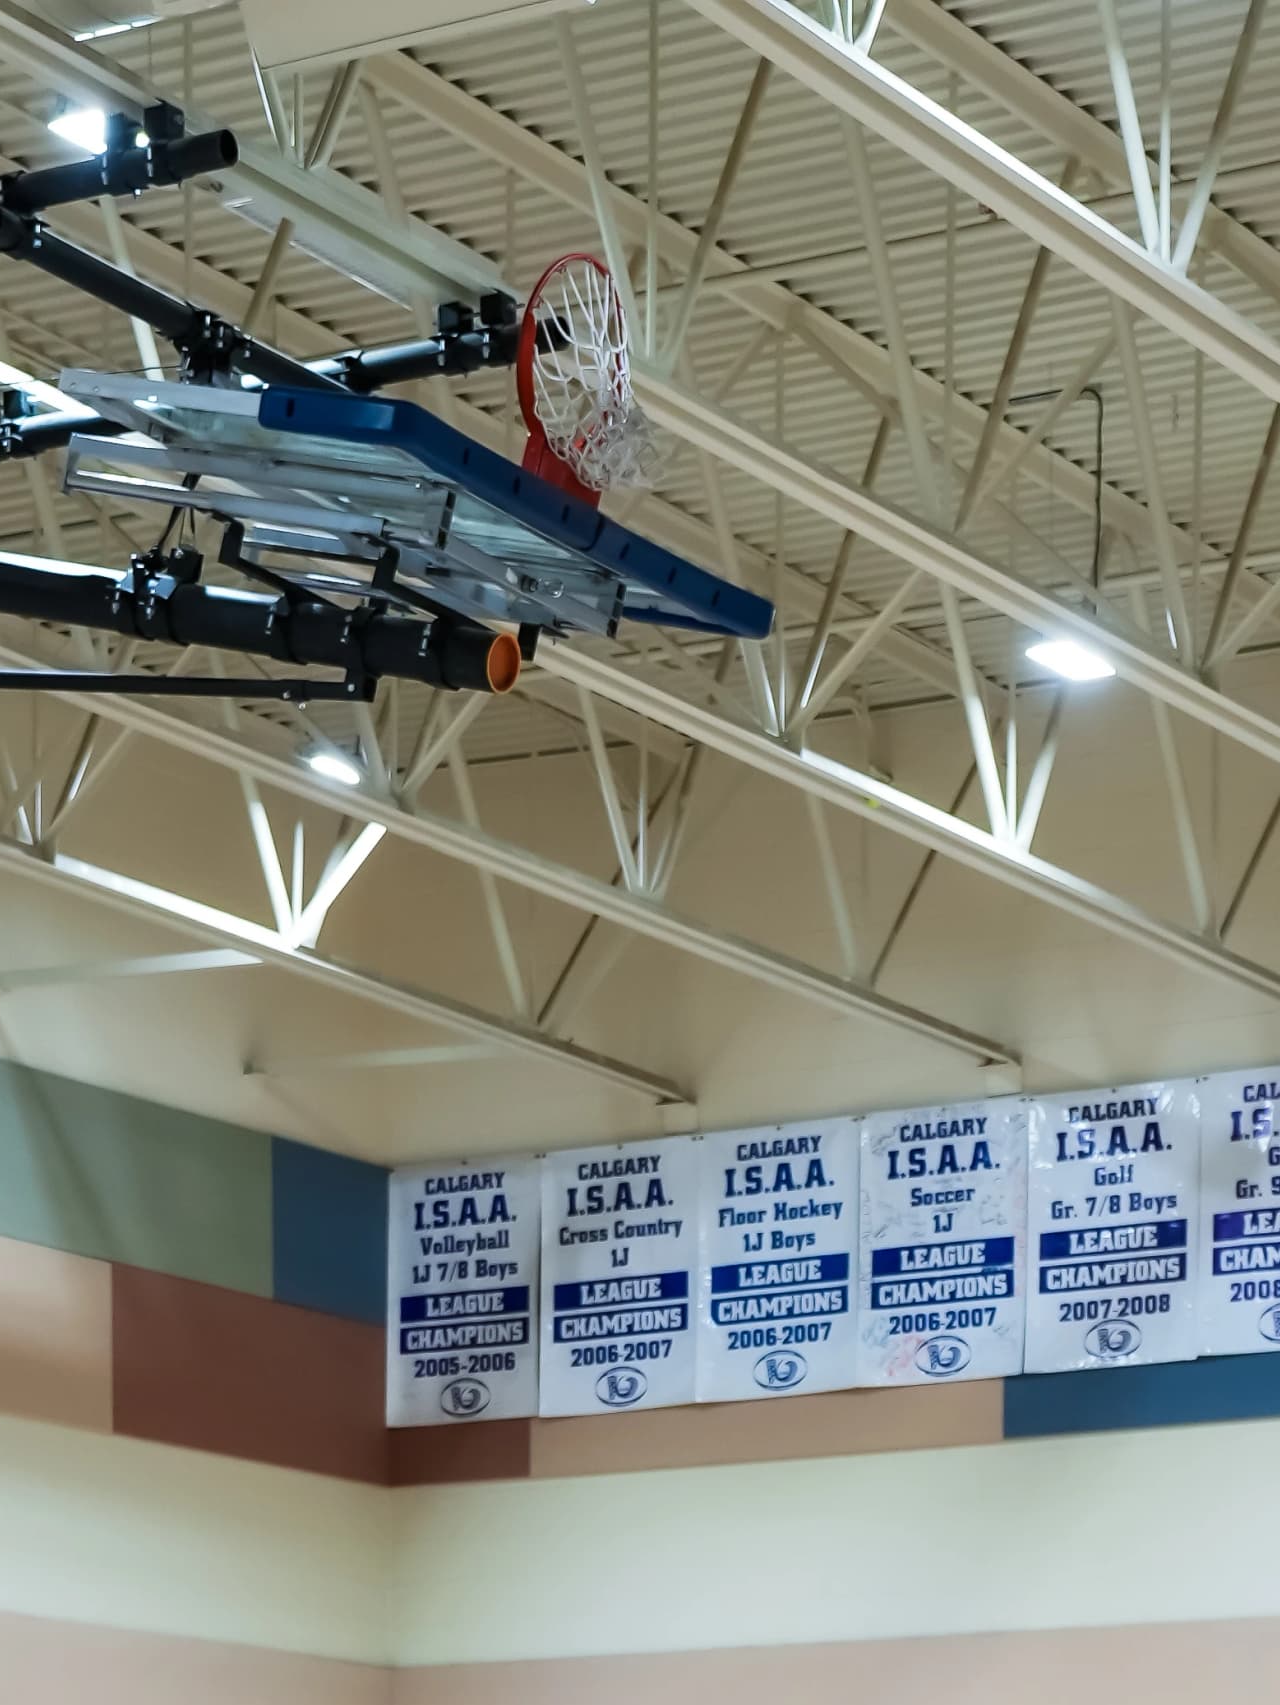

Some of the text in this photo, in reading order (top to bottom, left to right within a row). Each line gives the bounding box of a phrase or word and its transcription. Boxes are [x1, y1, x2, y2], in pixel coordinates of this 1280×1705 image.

[1068, 1098, 1158, 1124] CALGARY
[900, 1117, 987, 1142] CALGARY
[1057, 1122, 1172, 1162] I.S.A.A.
[737, 1135, 821, 1161] CALGARY
[887, 1141, 1000, 1180] I.S.A.A.
[578, 1155, 661, 1181] CALGARY
[725, 1159, 835, 1198] I.S.A.A.
[1094, 1165, 1134, 1187] Golf
[425, 1171, 505, 1196] CALGARY
[567, 1178, 673, 1217] I.S.A.A.
[911, 1187, 975, 1207] Soccer
[1236, 1179, 1263, 1200] Gr.
[414, 1195, 517, 1231] I.S.A.A.
[719, 1199, 842, 1228] Floor Hockey
[1051, 1192, 1177, 1220] Gr. 7/8 Boys
[559, 1218, 682, 1246] Cross Country
[933, 1213, 953, 1233] 1J
[420, 1230, 510, 1257] Volleyball
[743, 1230, 815, 1252] 1J Boys
[1070, 1226, 1158, 1255] LEAGUE
[611, 1248, 629, 1268] 1J
[900, 1242, 985, 1271] LEAGUE
[413, 1258, 519, 1284] 1J 7/8 Boys
[739, 1259, 821, 1287] LEAGUE
[1046, 1257, 1180, 1290] CHAMPIONS
[581, 1278, 661, 1306] LEAGUE
[878, 1274, 1007, 1306] CHAMPIONS
[426, 1292, 504, 1319] LEAGUE
[719, 1290, 842, 1322] CHAMPIONS
[1060, 1294, 1170, 1322] 2007-2008
[560, 1308, 682, 1340] CHAMPIONS
[889, 1307, 997, 1335] 2006-2007
[407, 1321, 523, 1351] CHAMPIONS
[728, 1322, 832, 1350] 2006-2007
[414, 1352, 515, 1378] 2005-2006
[570, 1340, 672, 1367] 2006-2007
